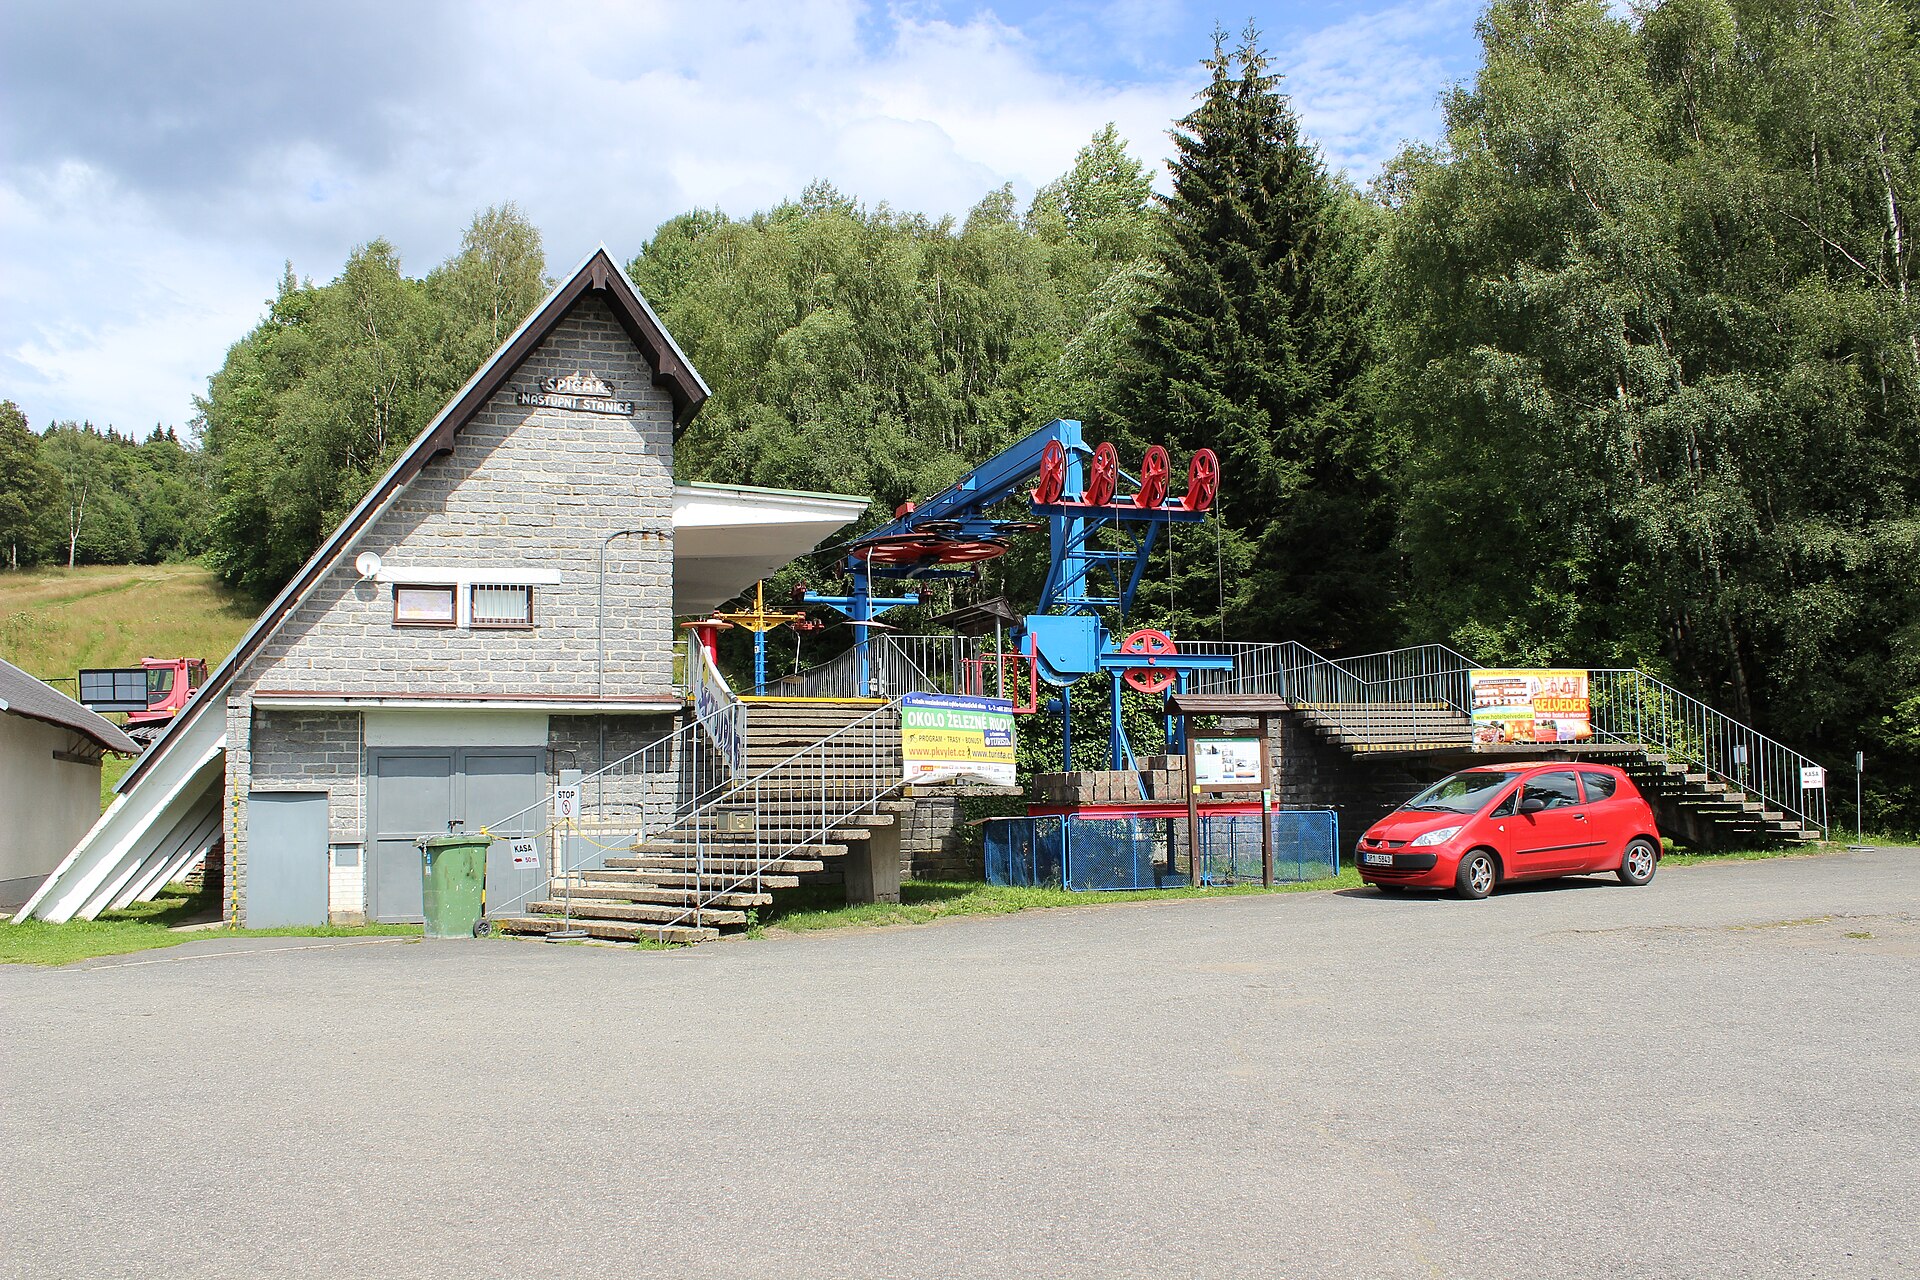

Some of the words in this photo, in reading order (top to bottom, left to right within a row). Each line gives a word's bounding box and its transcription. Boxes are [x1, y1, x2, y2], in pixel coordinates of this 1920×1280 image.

[582, 399, 631, 413] STANICE
[1534, 698, 1587, 712] BELVEDER
[908, 711, 945, 728] OKOLO
[947, 710, 987, 730] ŽELEZNÉ
[990, 715, 1012, 733] RUDY
[918, 733, 942, 743] PROGRAM
[947, 735, 961, 743] TRASY
[965, 736, 982, 745] BONUSY
[908, 746, 966, 759] www.pkvylet.cz
[557, 790, 575, 799] STOP
[513, 844, 533, 853] KASA
